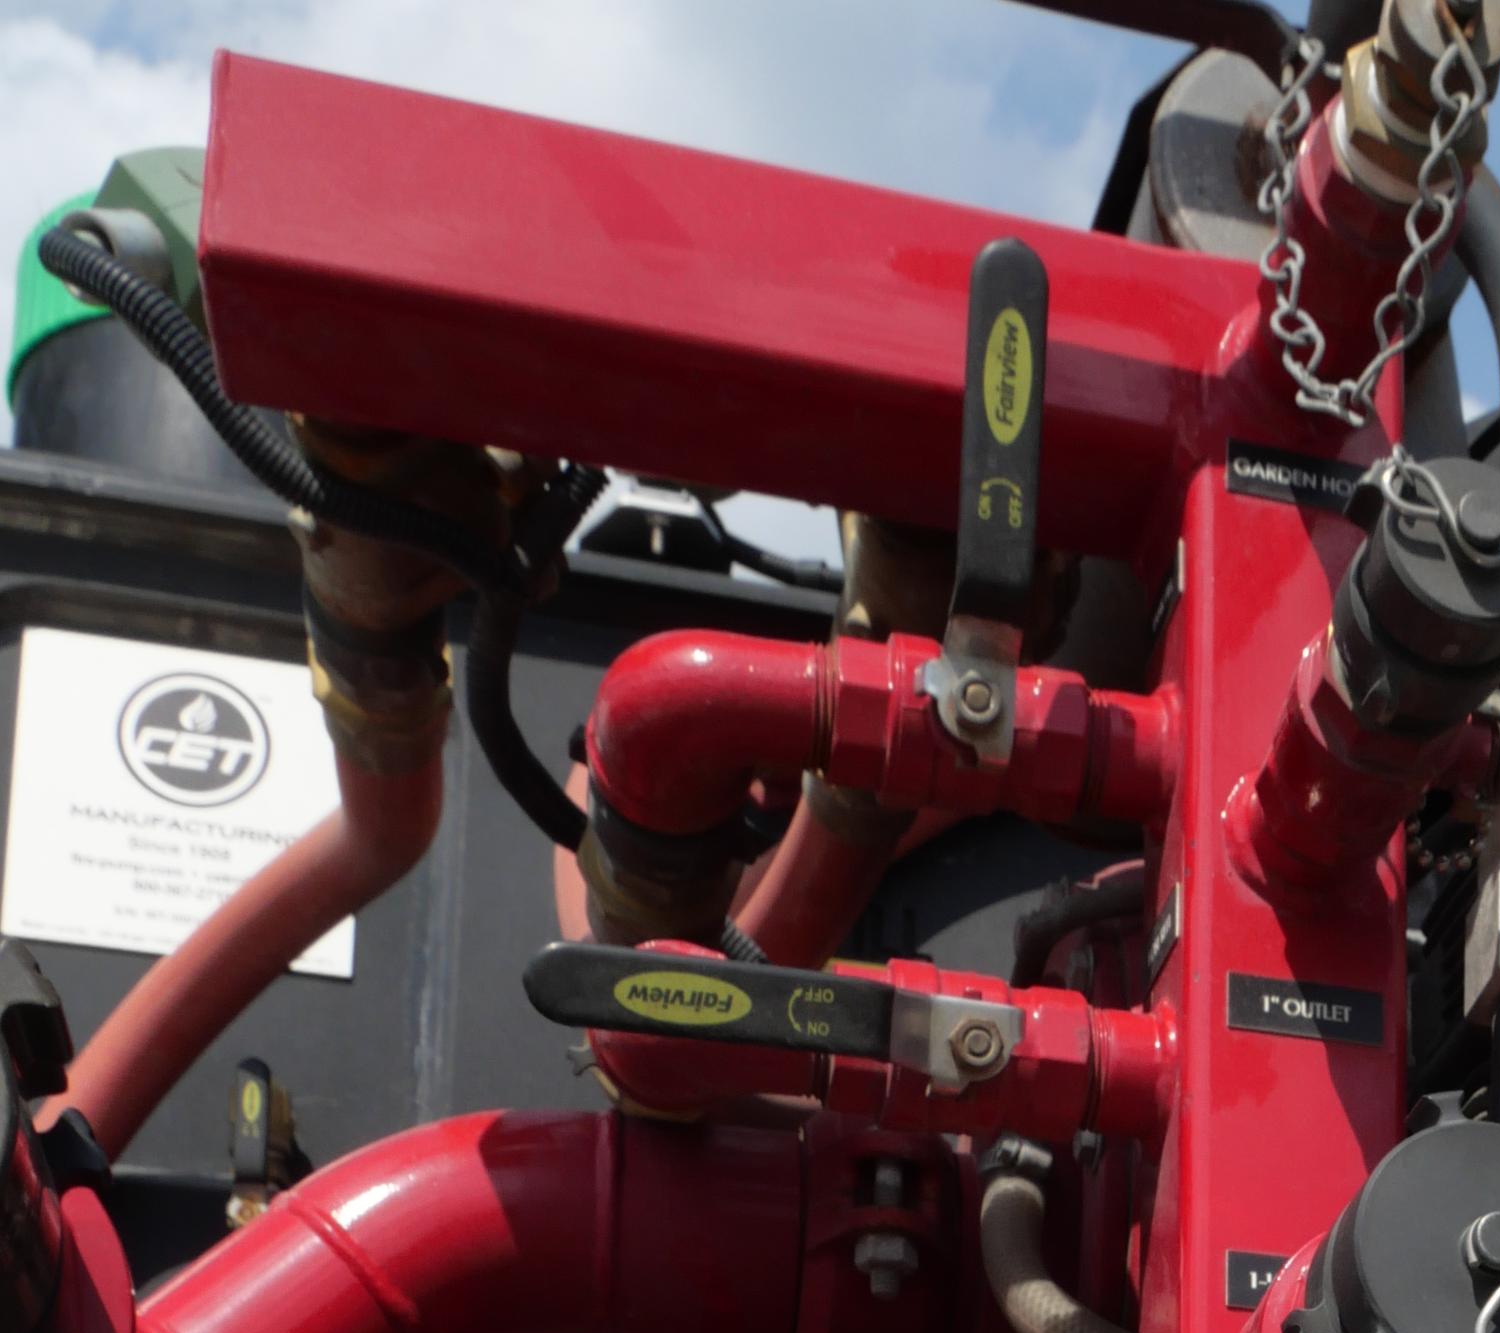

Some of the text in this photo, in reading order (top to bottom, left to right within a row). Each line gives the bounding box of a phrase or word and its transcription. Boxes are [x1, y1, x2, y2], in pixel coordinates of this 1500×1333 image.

[995, 320, 1019, 427] Fairview
[1232, 455, 1357, 497] GARDEN HO
[977, 495, 991, 521] ON
[1008, 495, 1022, 529] OFF
[134, 725, 254, 776] CET
[626, 983, 734, 1014] Fairview
[803, 986, 835, 1004] OFF
[1282, 998, 1352, 1024] OUTLET
[806, 1020, 831, 1036] ON
